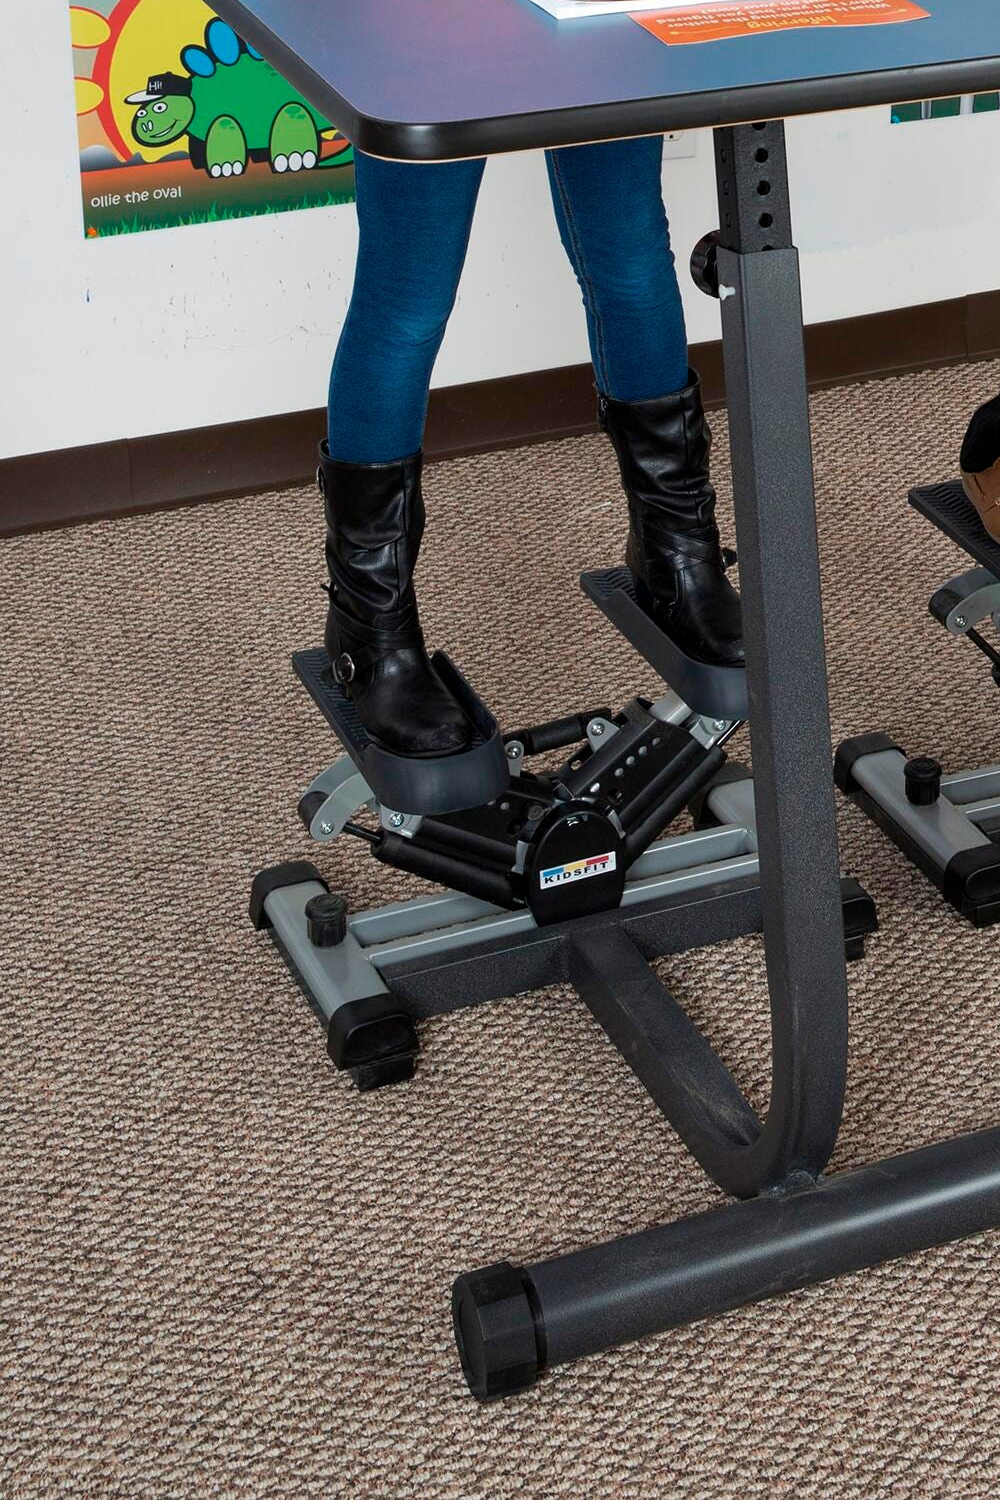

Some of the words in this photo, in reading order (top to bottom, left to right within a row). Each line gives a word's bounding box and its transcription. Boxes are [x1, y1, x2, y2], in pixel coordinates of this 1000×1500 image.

[149, 80, 162, 91] Hi!
[124, 190, 149, 205] the
[543, 861, 609, 886] KIDSFIT
